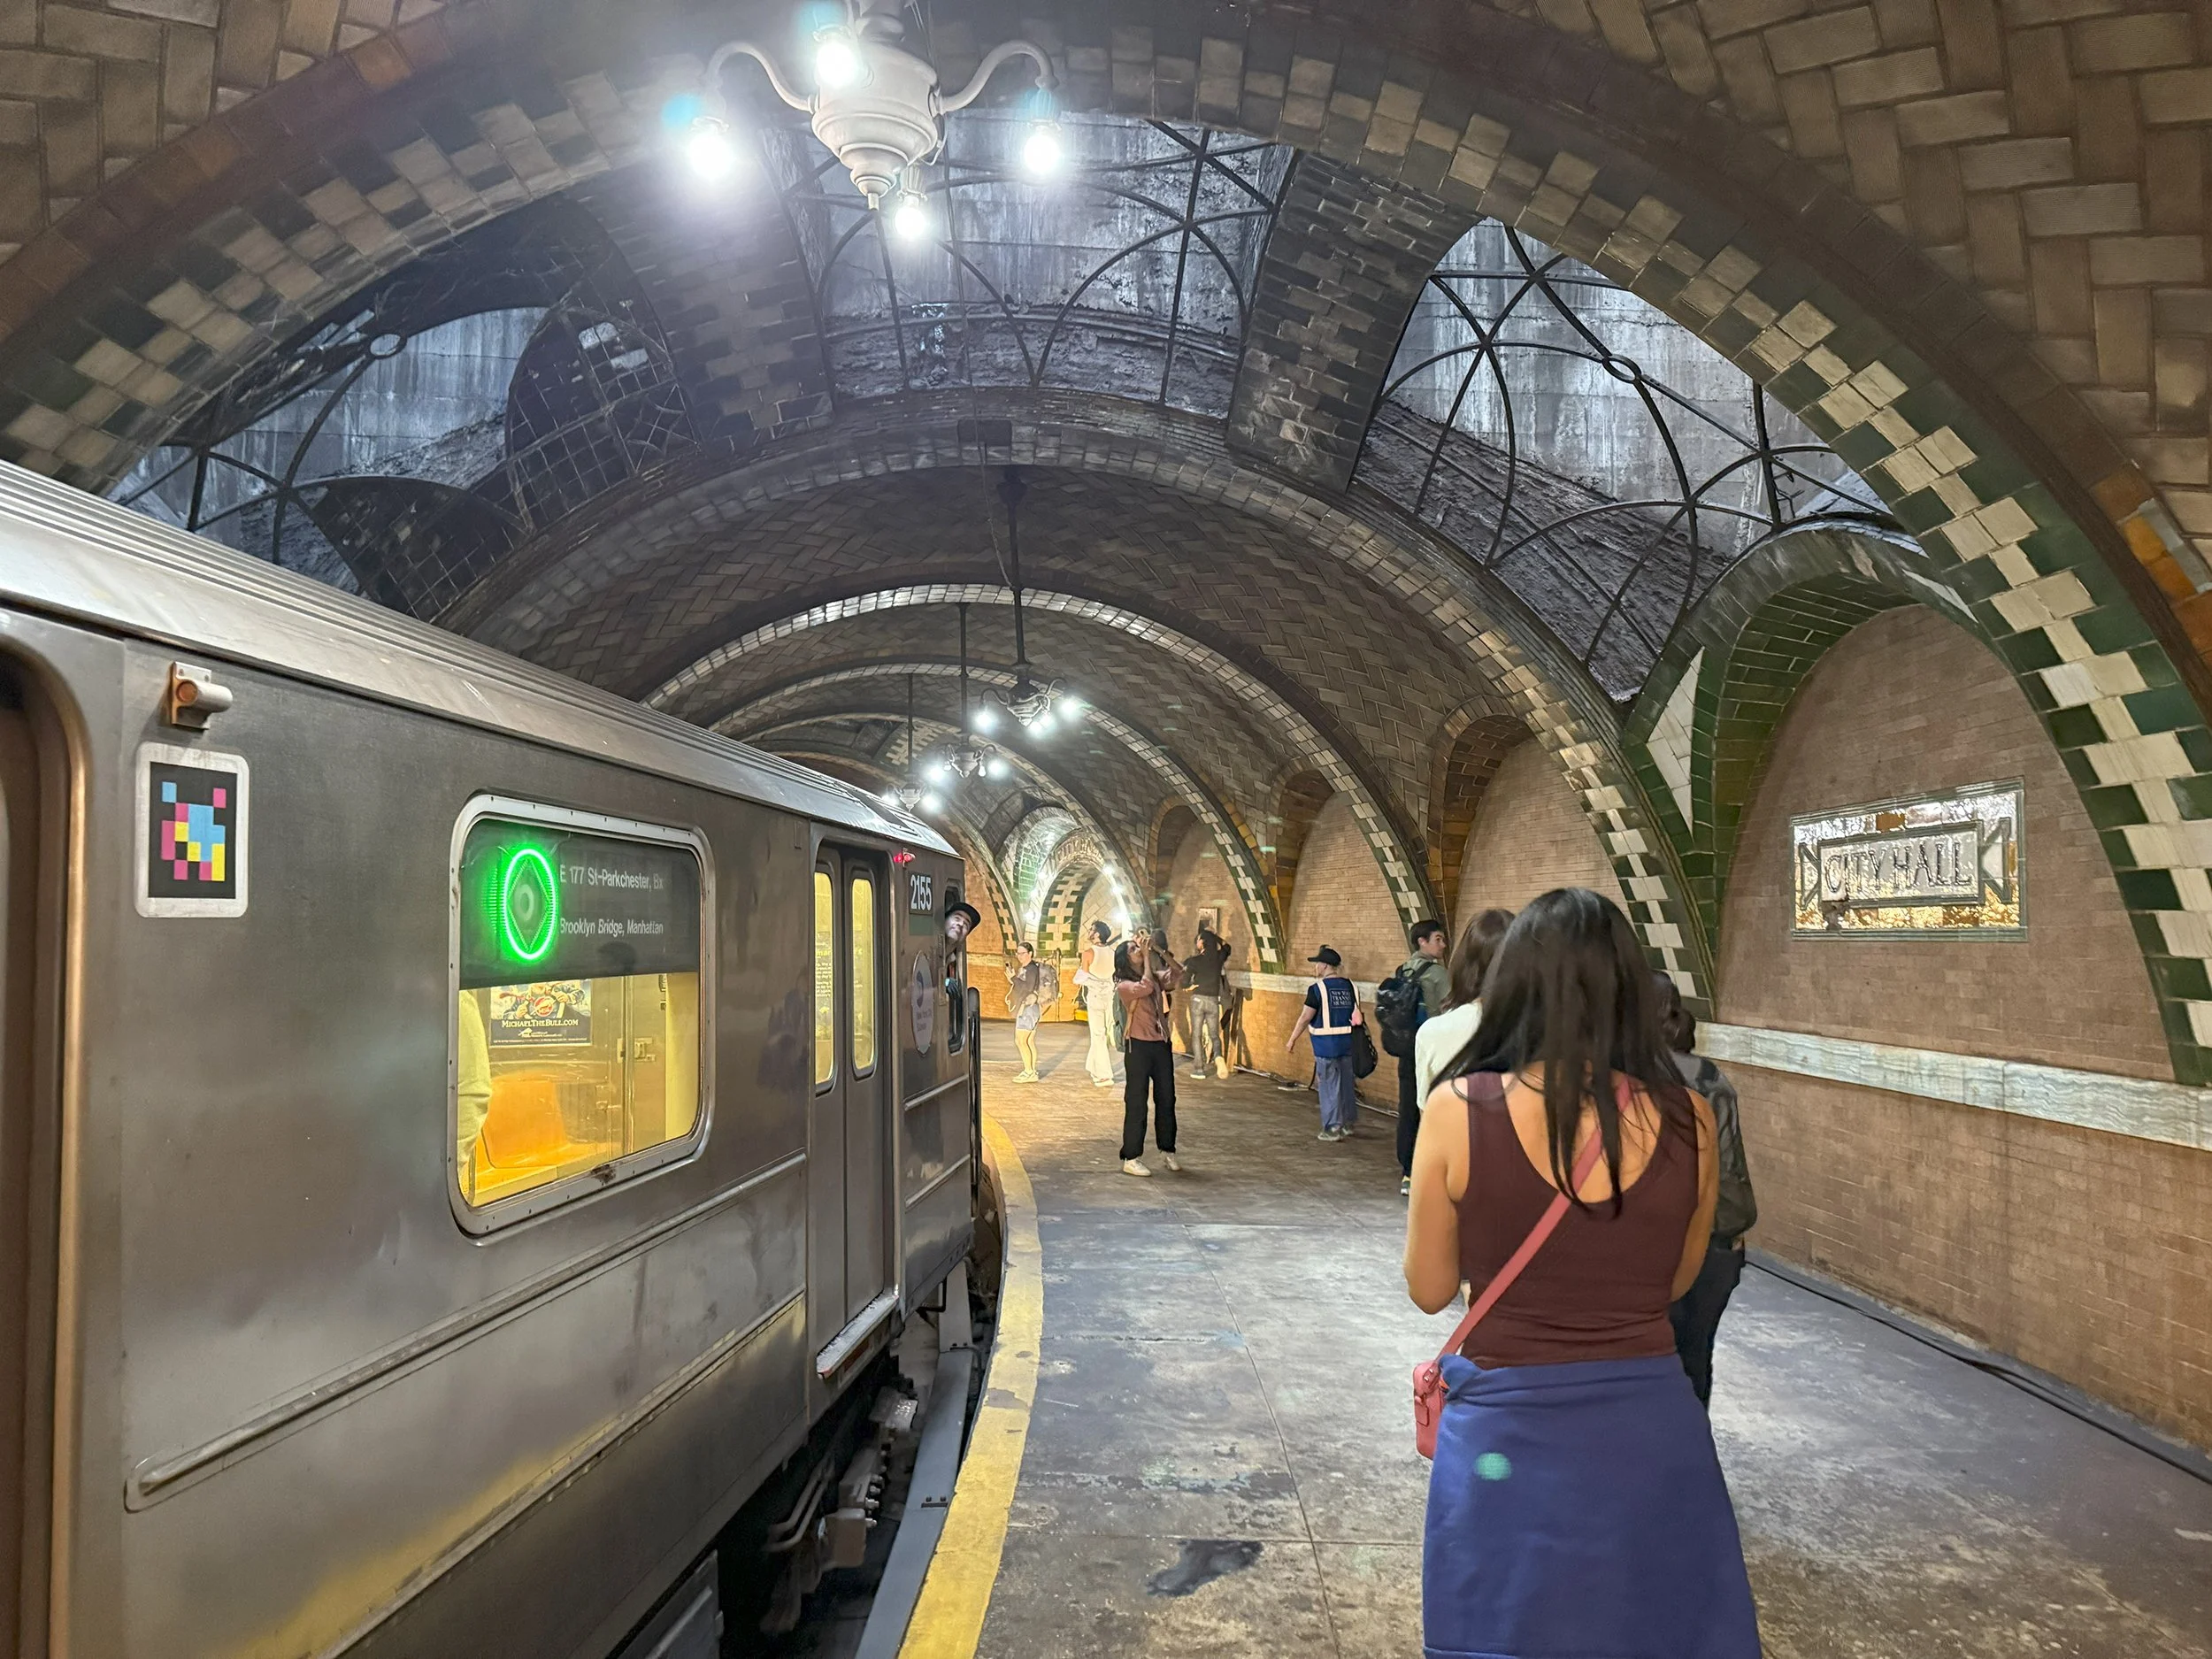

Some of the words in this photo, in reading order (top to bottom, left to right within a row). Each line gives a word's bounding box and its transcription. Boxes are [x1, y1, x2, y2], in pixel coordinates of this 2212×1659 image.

[560, 864, 567, 883] E
[570, 866, 584, 884] 177
[588, 867, 652, 892] St-Parkchester,
[1824, 848, 1886, 893] CITY
[1893, 841, 1972, 888] HALL
[910, 874, 932, 910] 2155
[560, 918, 595, 937] Brooklyn
[598, 918, 625, 937] Bridge,
[626, 918, 664, 935] Manhattan
